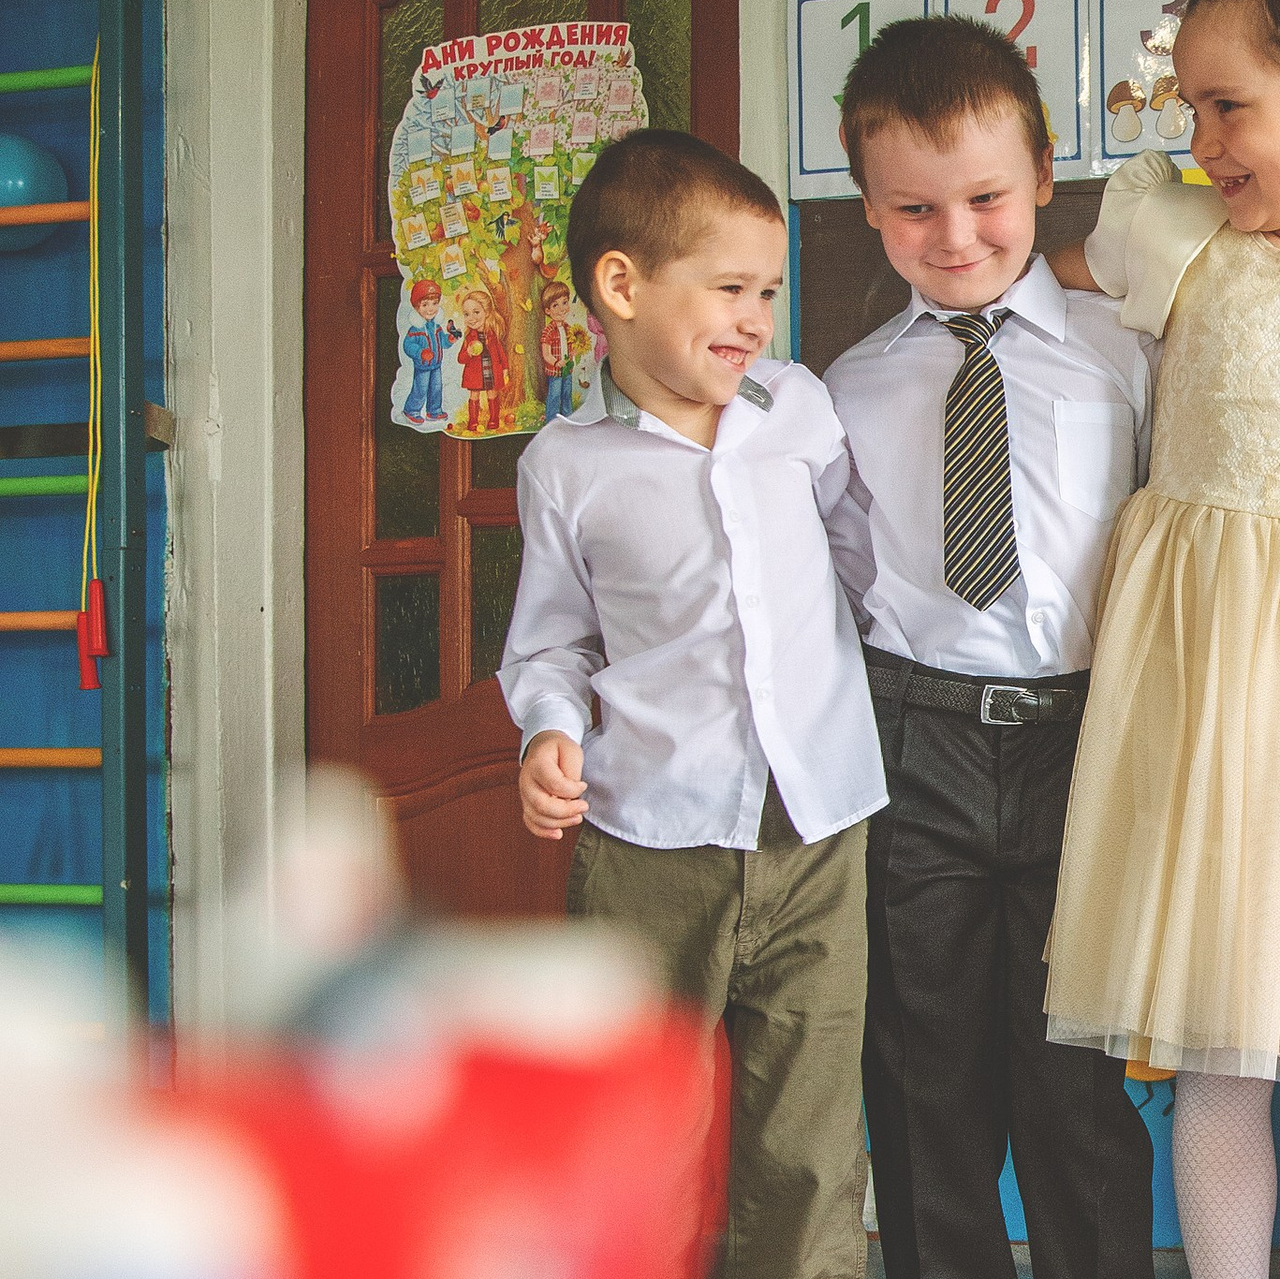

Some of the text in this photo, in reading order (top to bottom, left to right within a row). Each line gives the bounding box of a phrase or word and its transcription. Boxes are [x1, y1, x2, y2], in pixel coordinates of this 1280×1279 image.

[421, 23, 629, 74] ДНИ РОЖДЕНИЯ
[453, 48, 597, 82] КРУГЛЫЙ ГОД!
